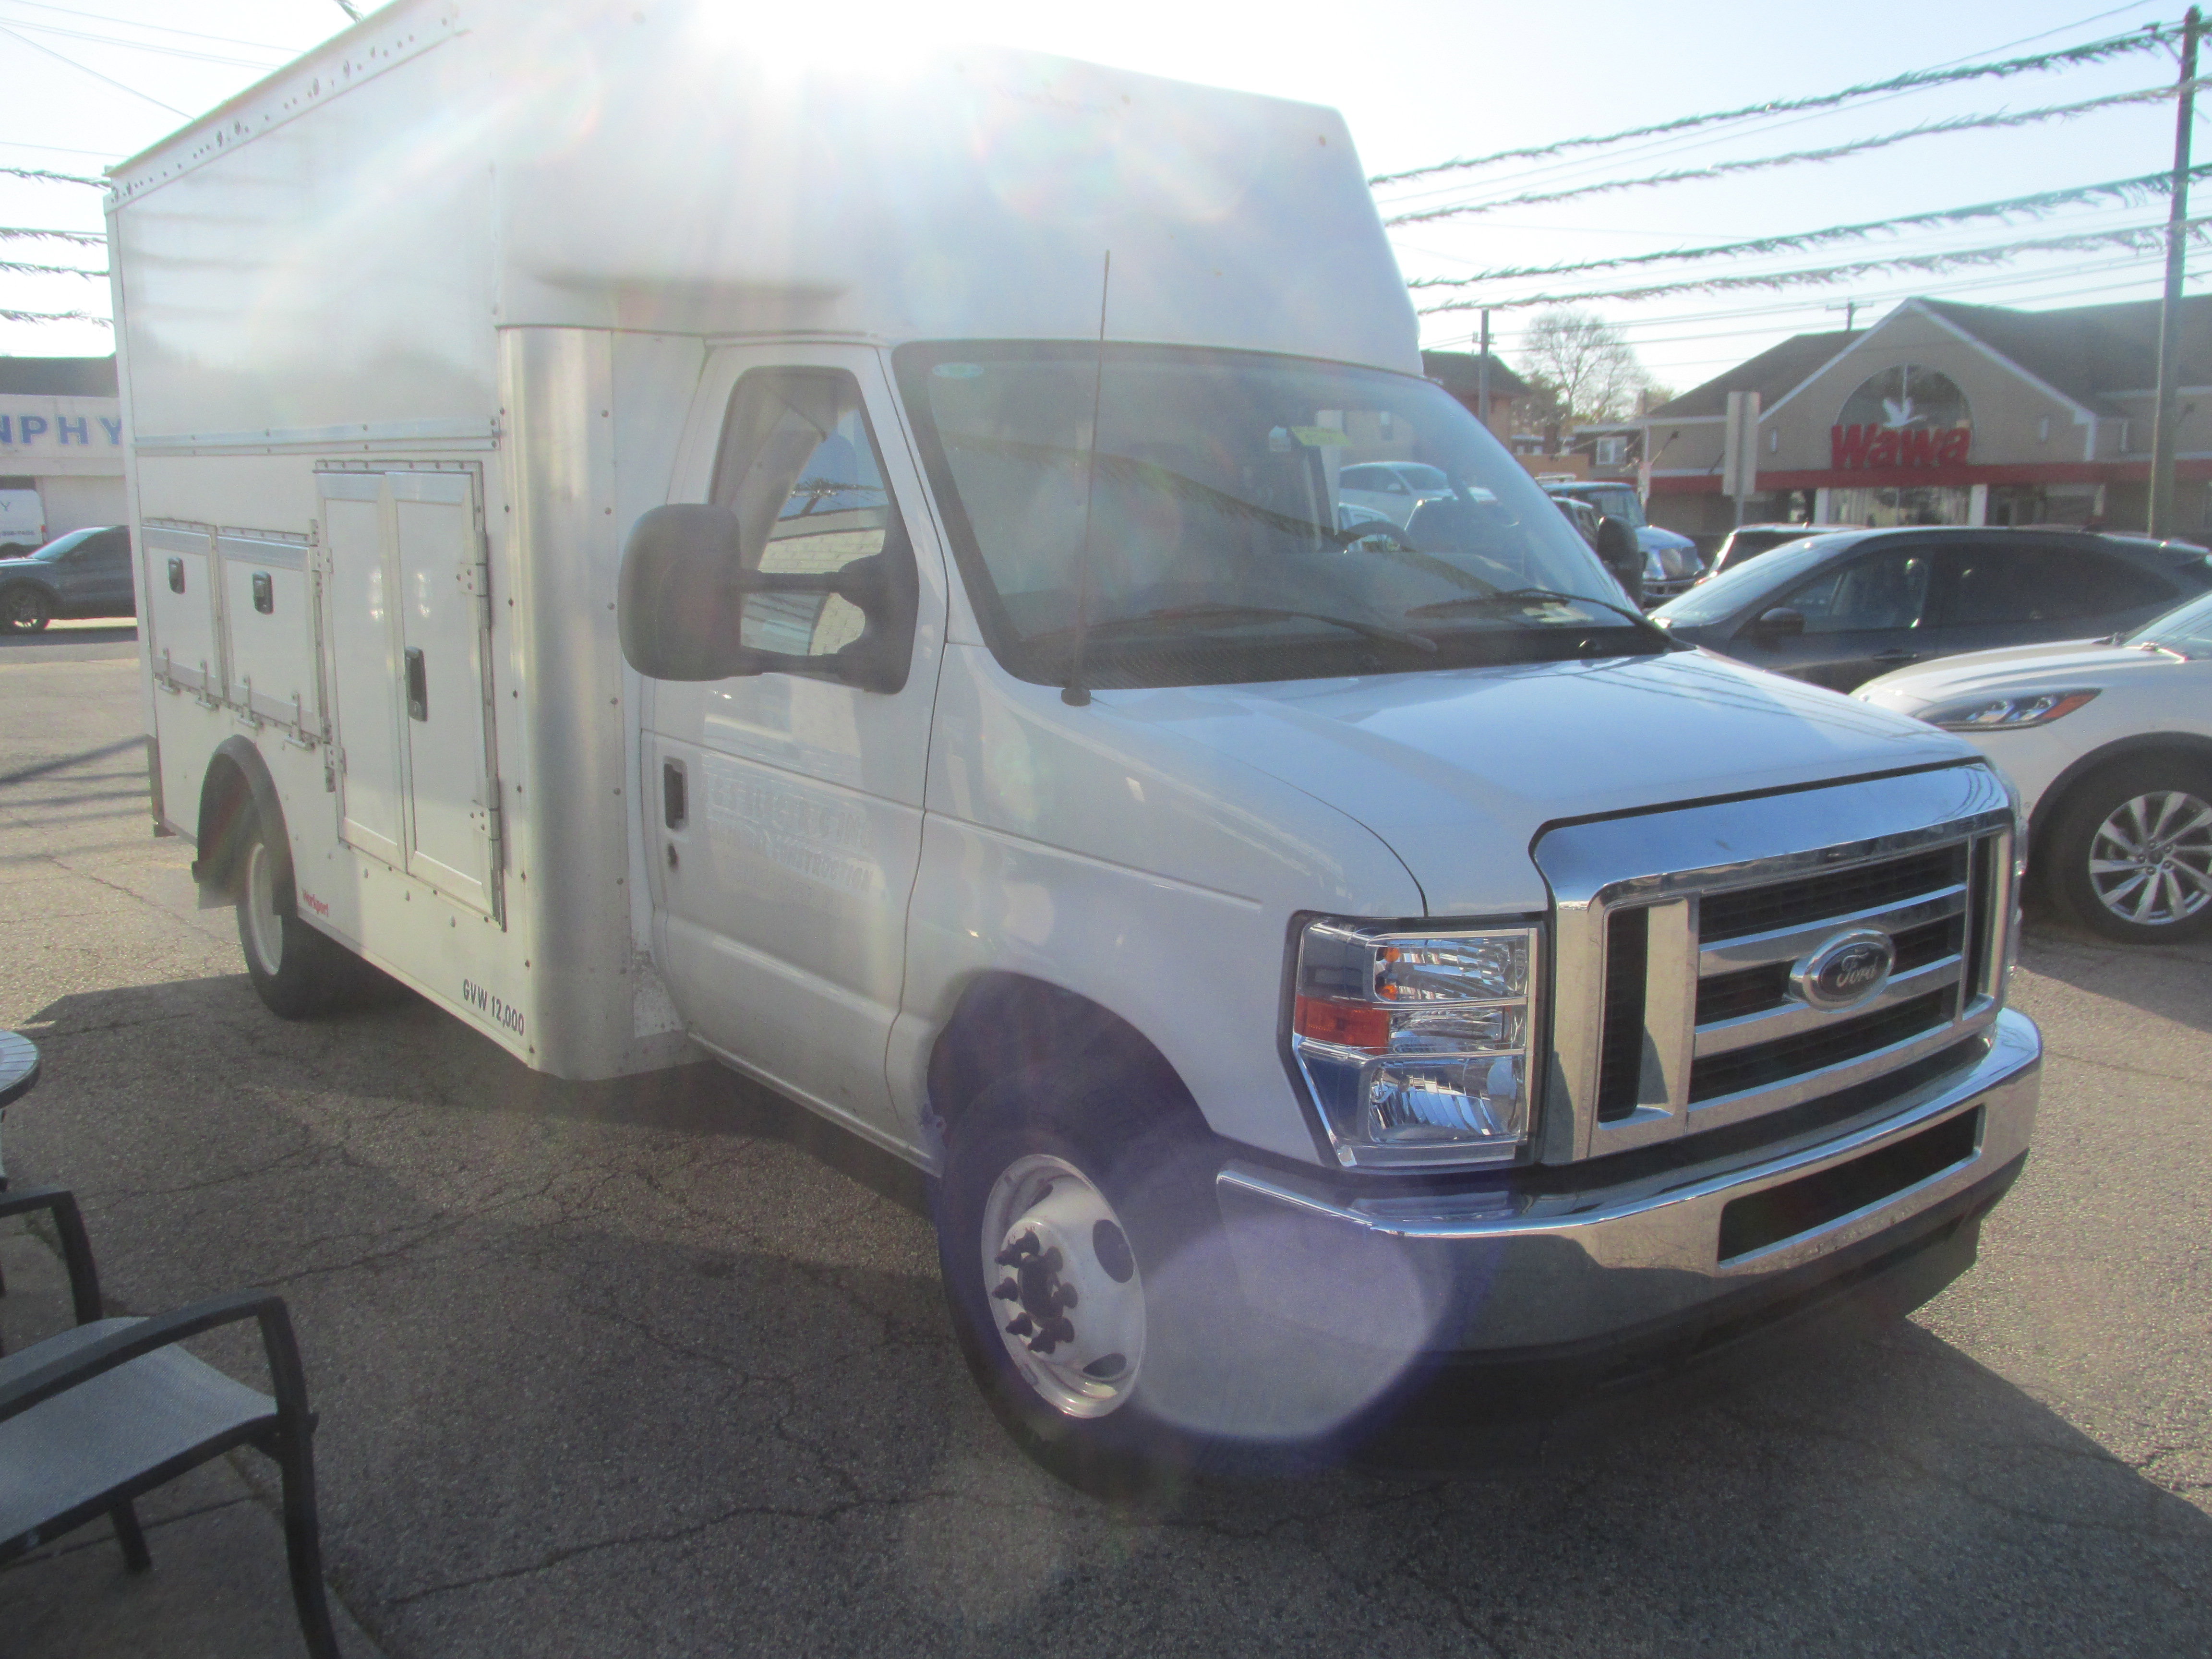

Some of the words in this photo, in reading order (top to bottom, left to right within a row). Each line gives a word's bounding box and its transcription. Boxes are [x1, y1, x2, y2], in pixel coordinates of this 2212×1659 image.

[1831, 423, 1972, 469] Wawa
[1837, 952, 1878, 987] Ford
[463, 979, 488, 1011] GVW
[492, 996, 525, 1036] 12,000
